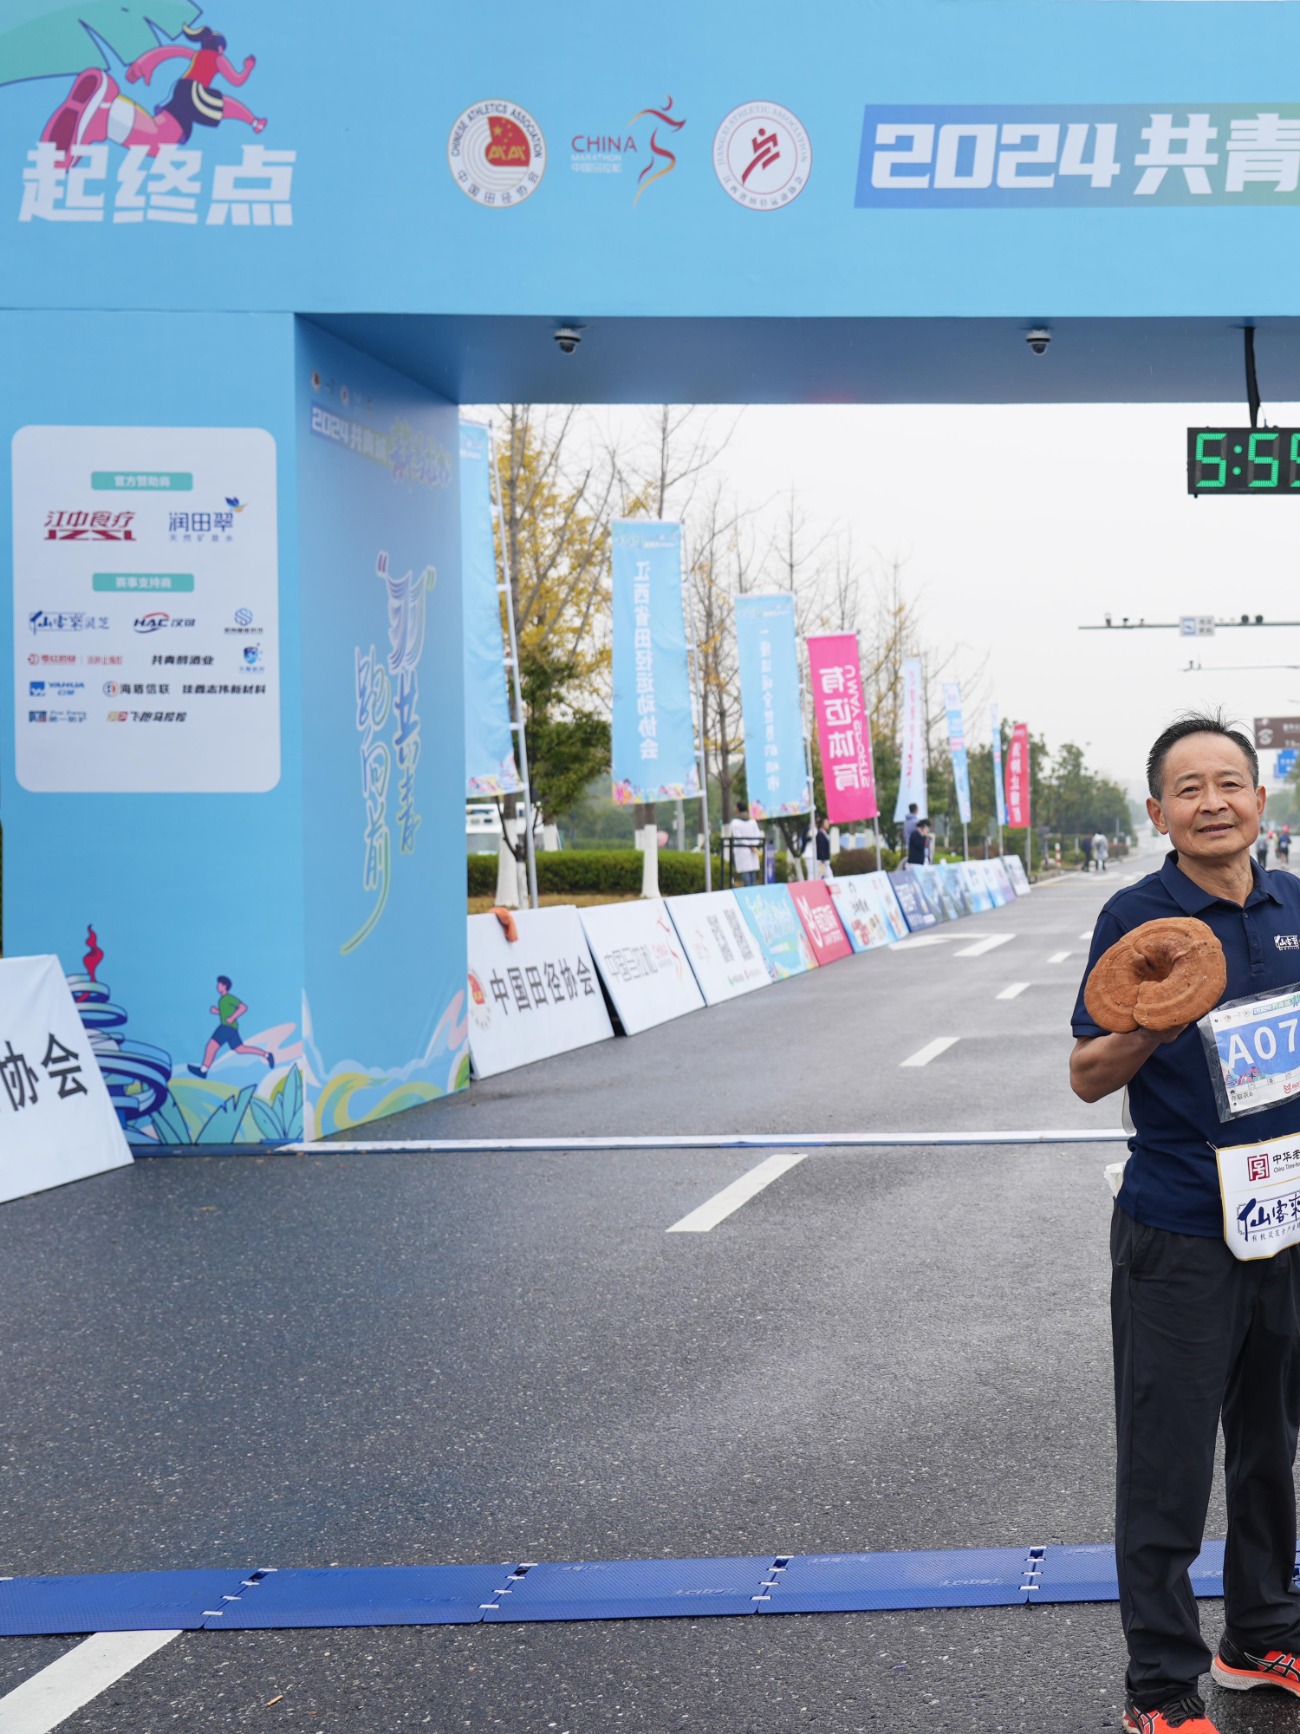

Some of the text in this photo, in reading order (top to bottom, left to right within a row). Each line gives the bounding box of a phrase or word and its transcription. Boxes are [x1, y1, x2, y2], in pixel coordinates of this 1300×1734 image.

[571, 135, 638, 153] CHINA
[18, 141, 297, 227] 起终点
[43, 510, 137, 528] 江中食疗
[168, 512, 234, 533] 润田翠
[133, 617, 171, 629] HAC
[489, 954, 596, 1016] 中国田径协会
